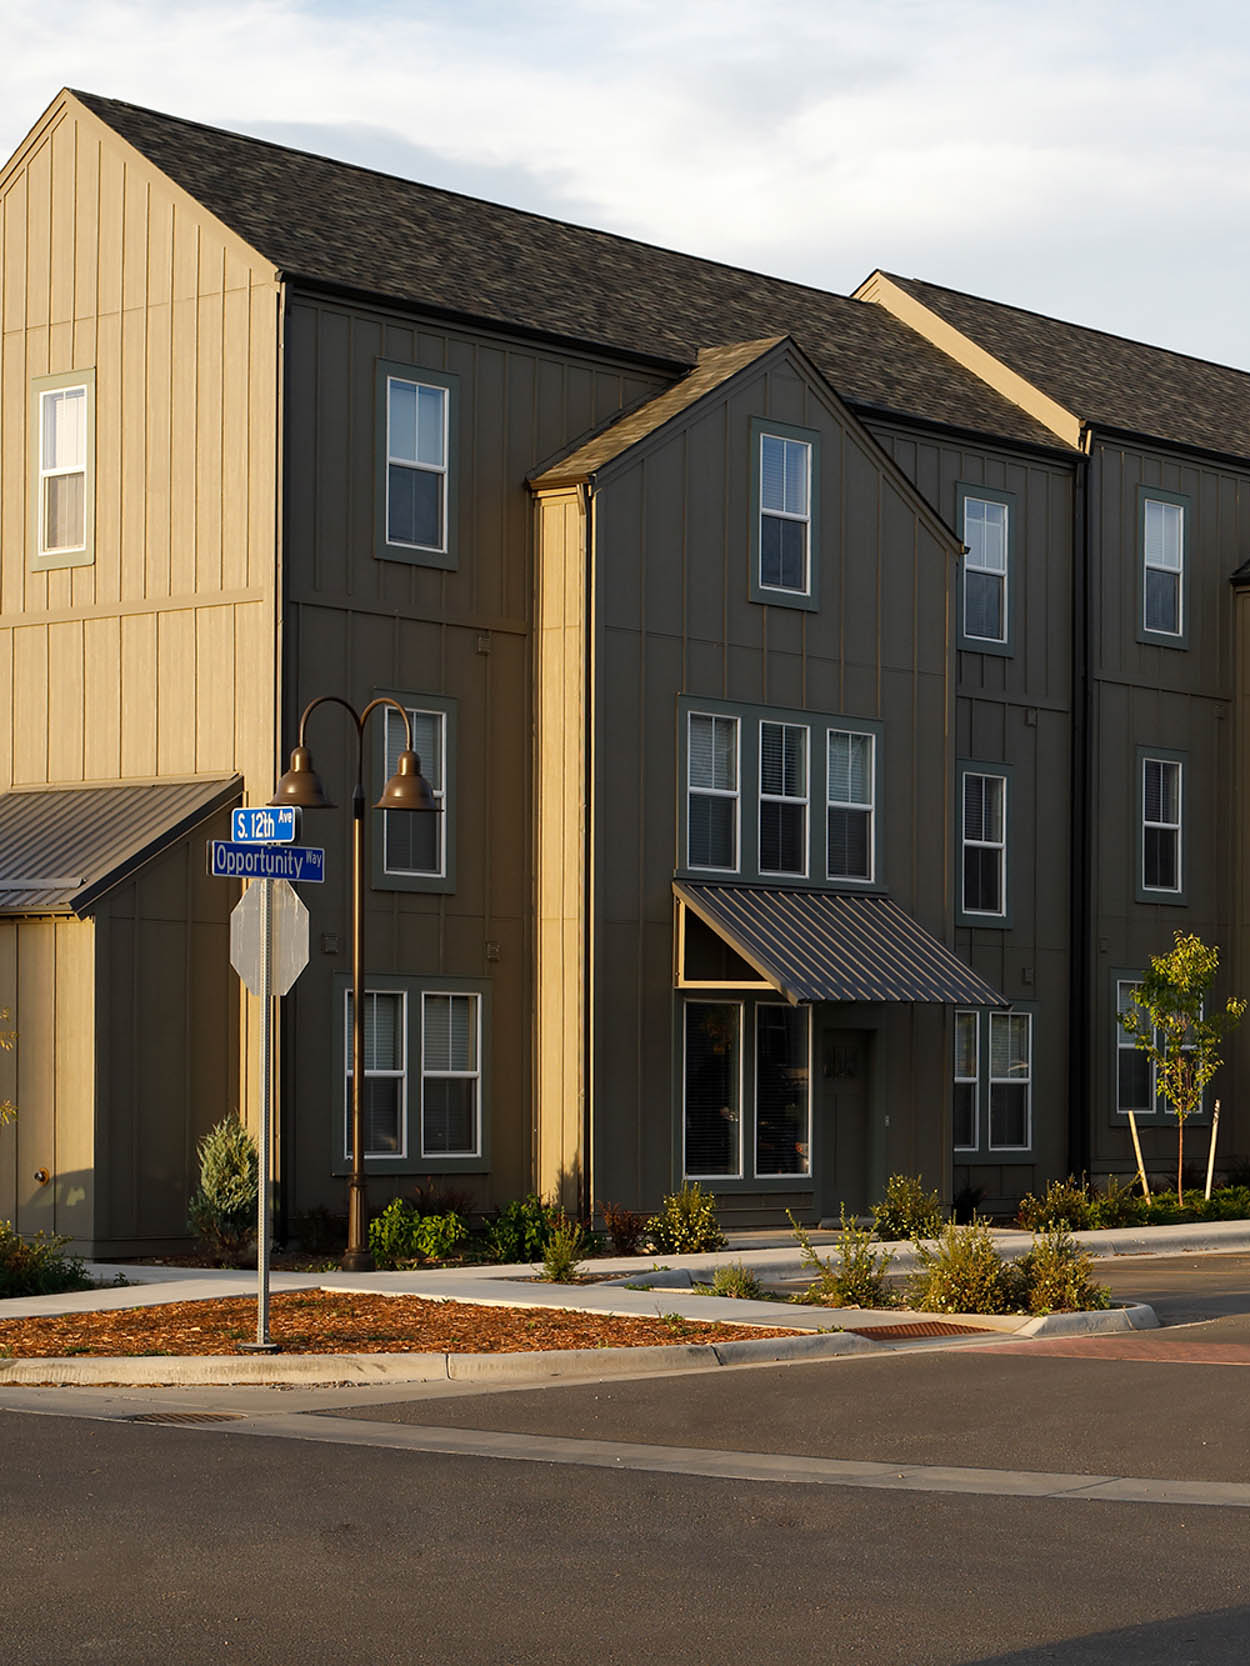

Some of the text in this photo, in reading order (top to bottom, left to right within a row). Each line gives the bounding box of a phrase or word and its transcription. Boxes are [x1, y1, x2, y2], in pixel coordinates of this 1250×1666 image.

[237, 809, 293, 839] S. 12th Ave
[216, 844, 322, 878] Opportunity Way
